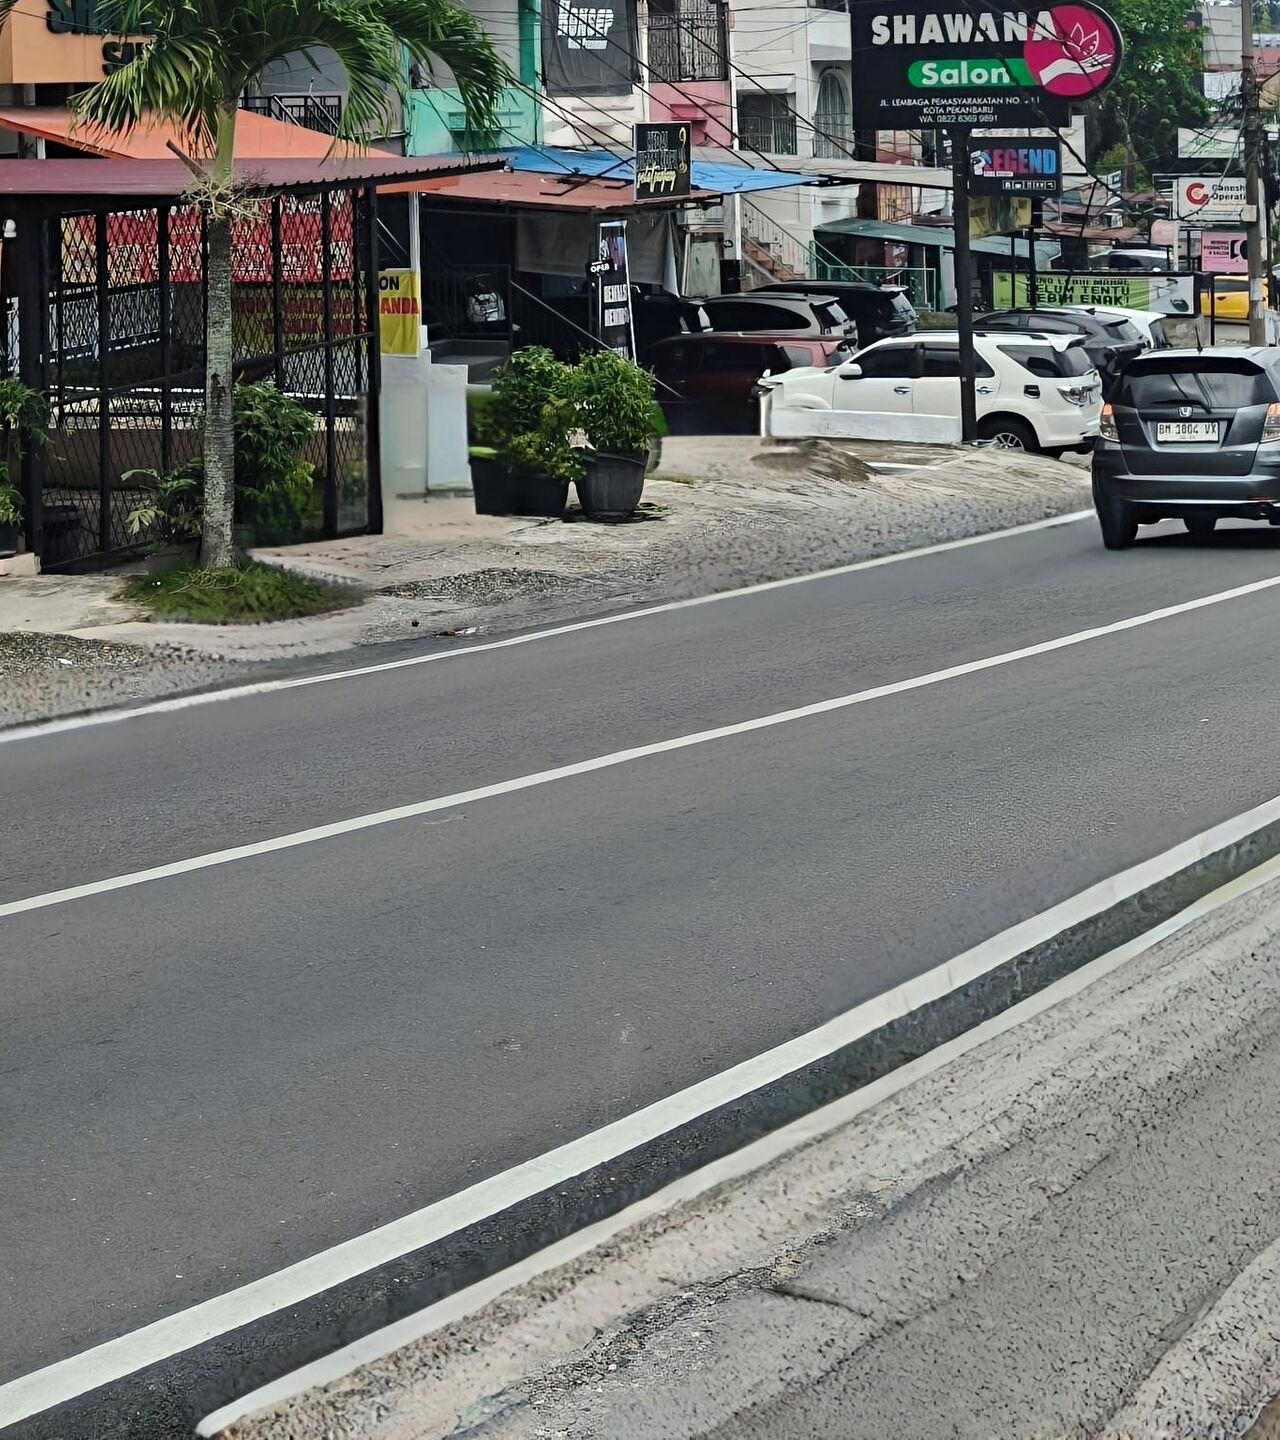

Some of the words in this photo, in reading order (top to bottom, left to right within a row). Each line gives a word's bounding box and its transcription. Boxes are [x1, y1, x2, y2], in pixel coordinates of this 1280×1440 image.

[871, 10, 1058, 45] SHAWANA
[921, 60, 1010, 85] Salon
[892, 98, 930, 107] LEMBAGA
[923, 106, 945, 115] KOTA
[946, 105, 994, 114] PEKANBARU
[1082, 285, 1130, 296] TENTU
[380, 297, 420, 315] ANDA
[1080, 294, 1130, 307] ENAK!
